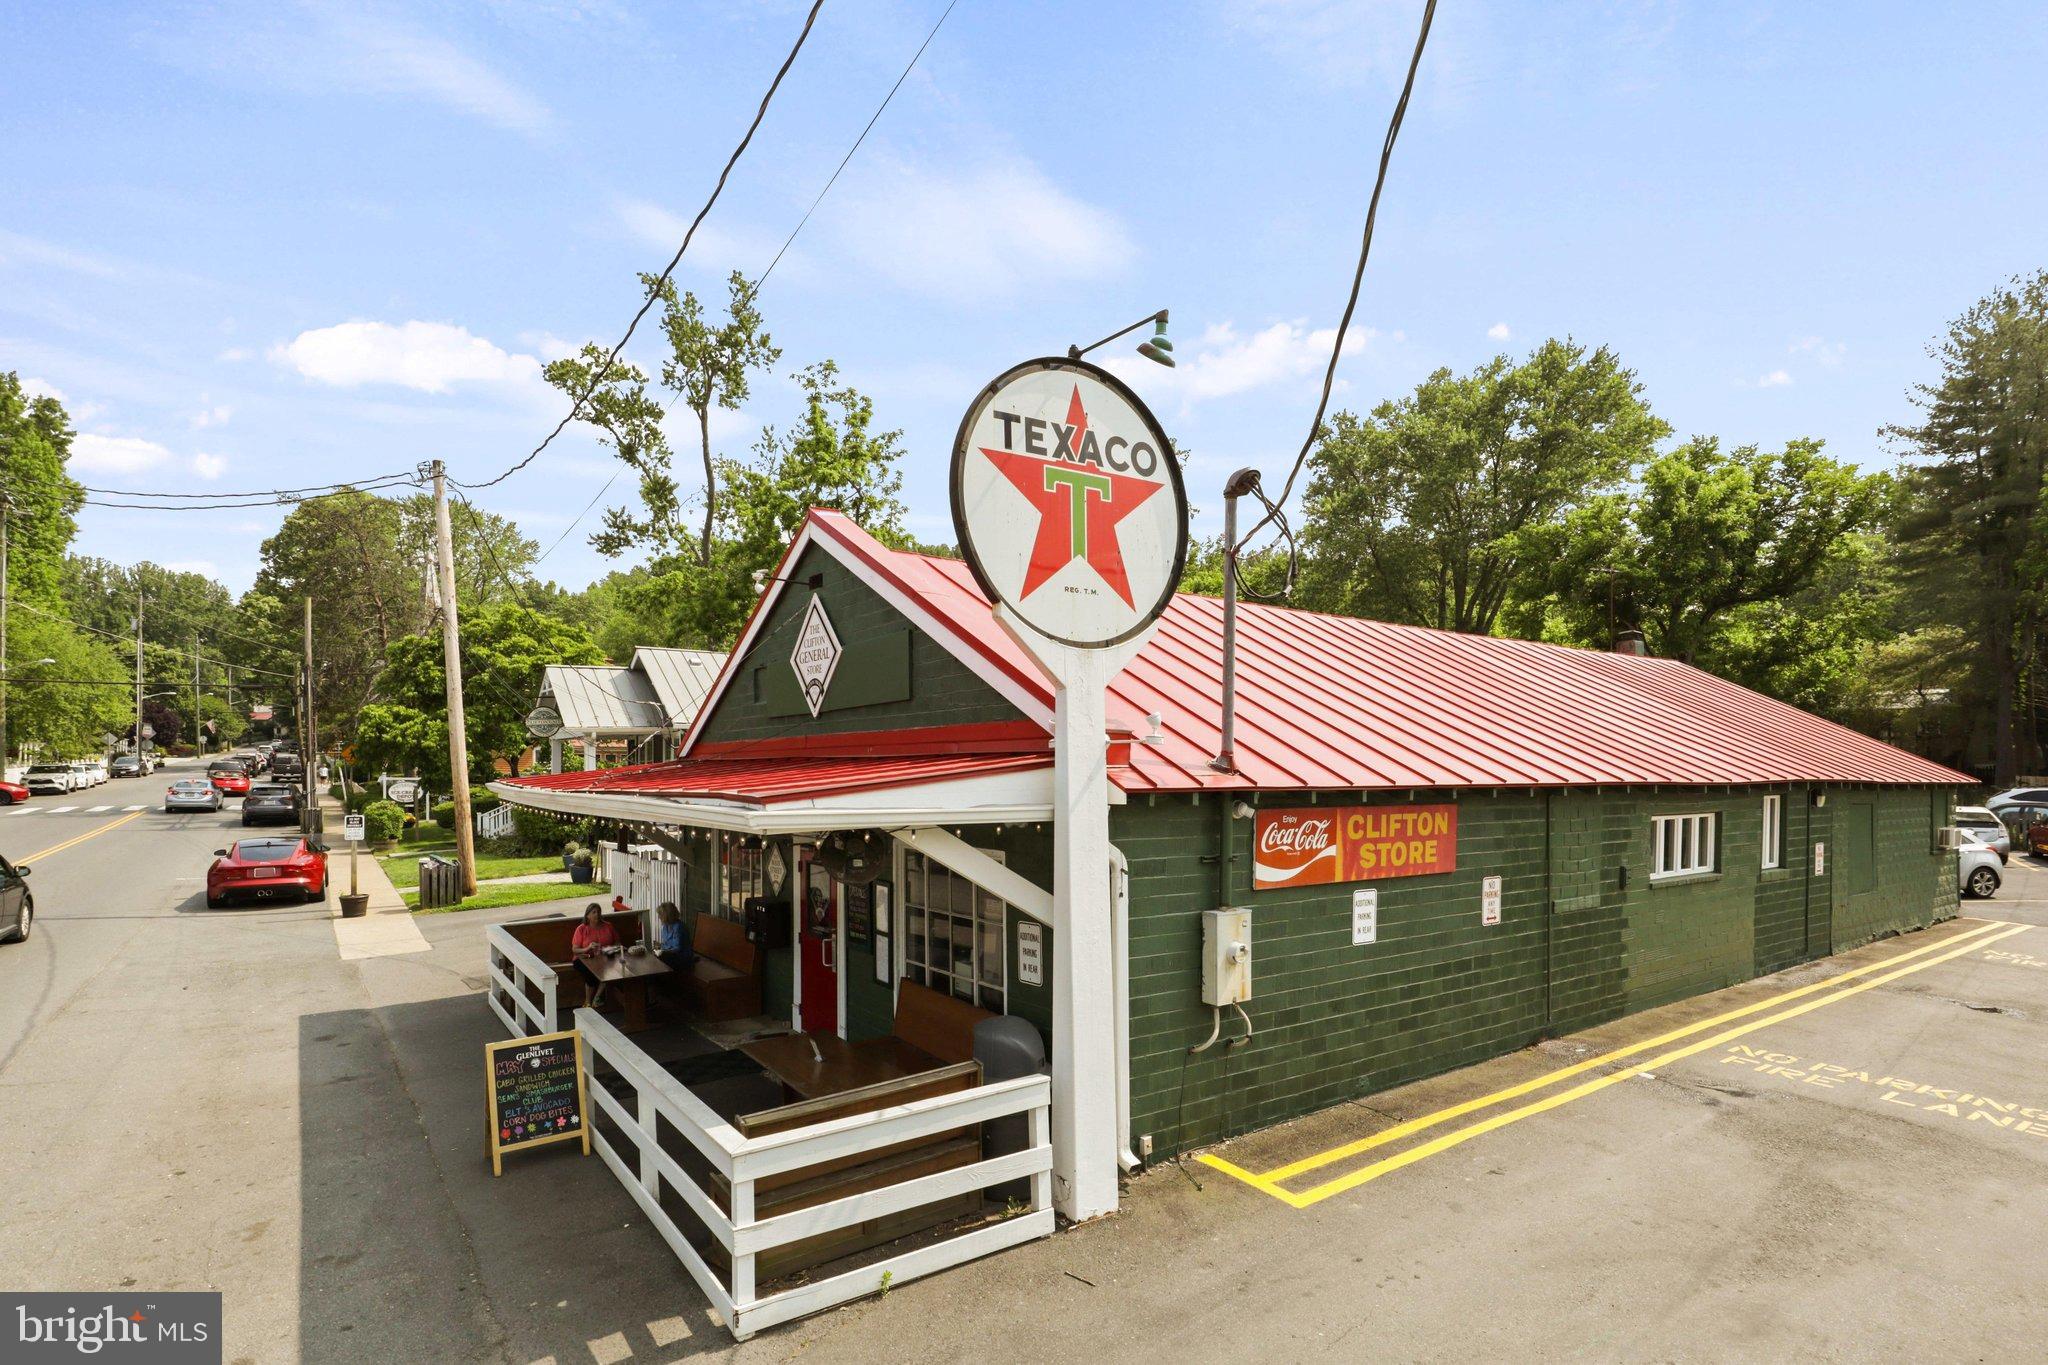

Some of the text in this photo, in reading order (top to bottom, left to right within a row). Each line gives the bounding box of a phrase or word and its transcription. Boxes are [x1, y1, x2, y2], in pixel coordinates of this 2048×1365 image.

[993, 410, 1157, 477] TEXACO
[1064, 586, 1081, 595] REG.
[810, 624, 820, 635] THE
[804, 635, 825, 649] CLIFTON
[800, 647, 830, 664] GENERAL
[807, 664, 822, 675] STORE
[1283, 815, 1298, 824] Enjoy
[1347, 812, 1449, 840] CLIFTON
[1261, 820, 1332, 853] Coca-Cola
[1359, 840, 1438, 869] STORE
[1355, 899, 1374, 907] ADDITIONAL
[1357, 912, 1371, 920] PARKING
[1020, 932, 1040, 943] ADDITIONAL
[1022, 947, 1037, 958] PARKING
[1023, 963, 1038, 974] IN REAR
[516, 1048, 554, 1061] GLENLIVET
[541, 1053, 576, 1067] SPECIALS
[1727, 1045, 1798, 1064] NO
[518, 1072, 547, 1083] GRILLED
[549, 1066, 575, 1078] CHICKEN
[1719, 1055, 1846, 1088] FIRE
[514, 1080, 550, 1093] SANDWICH
[522, 1096, 543, 1105] CLUB
[505, 1107, 521, 1118] BLT
[532, 1097, 571, 1112] AVOCADO
[503, 1105, 573, 1128] CORN DOG BITES
